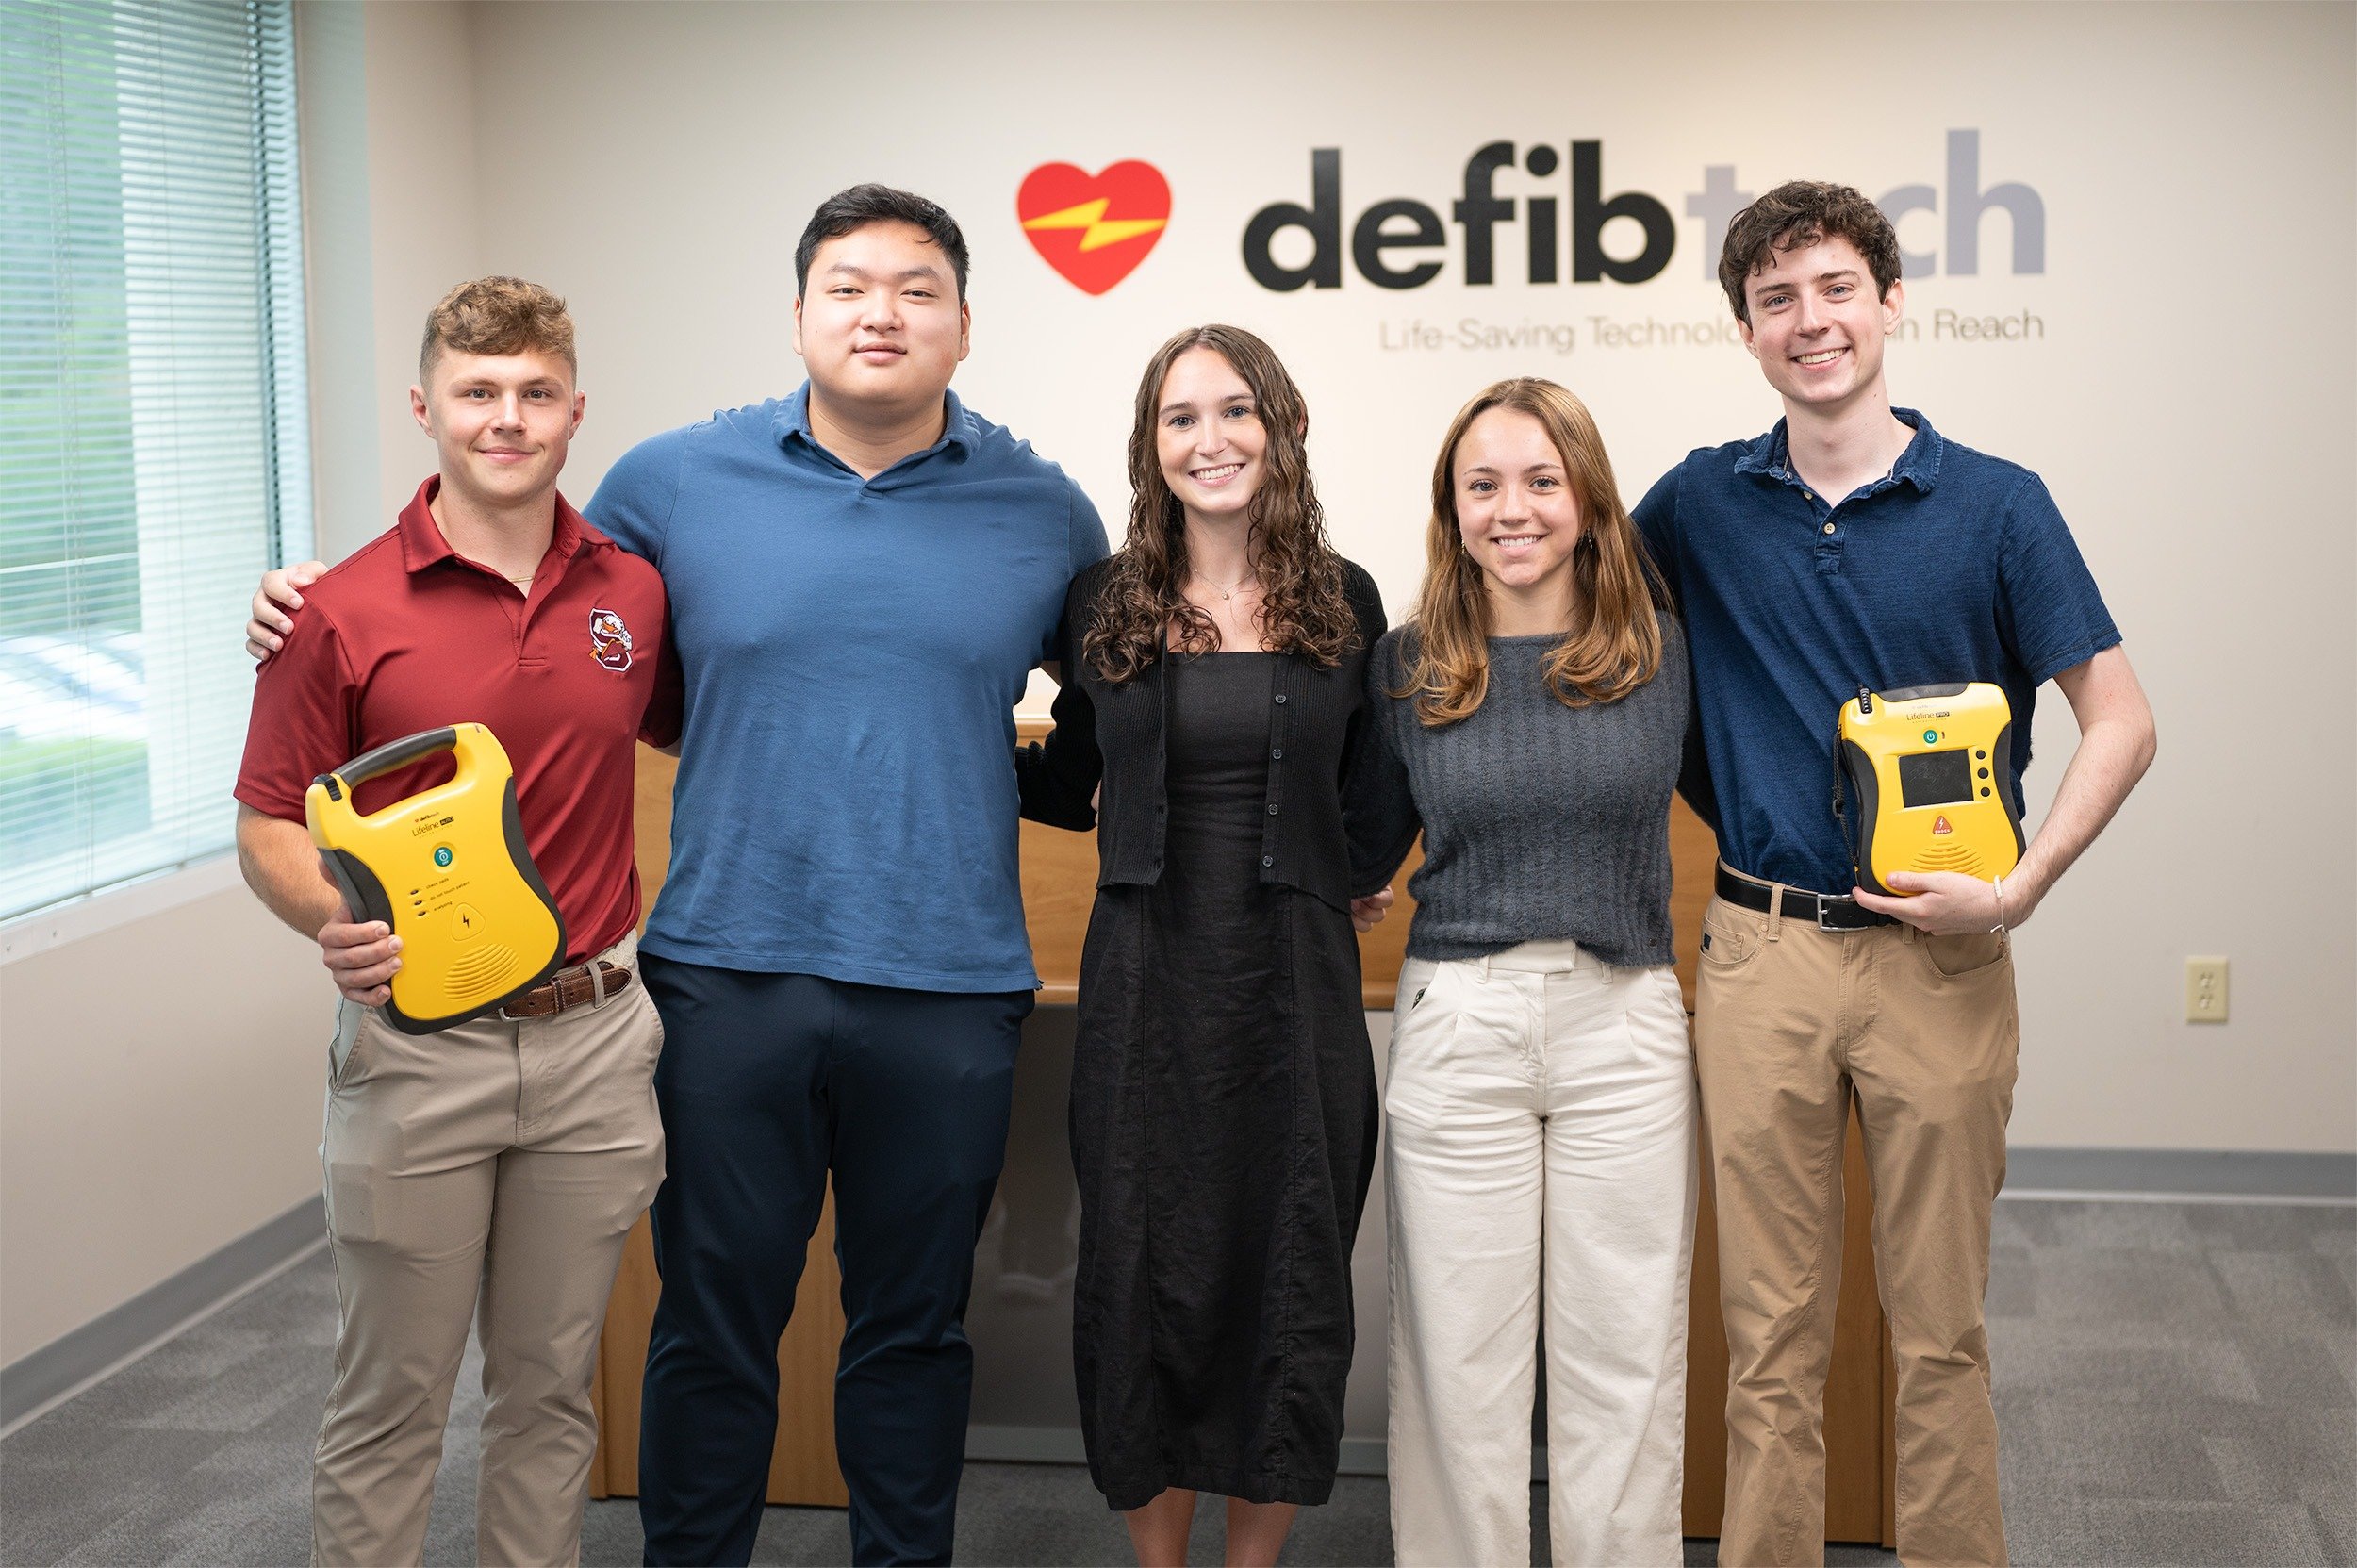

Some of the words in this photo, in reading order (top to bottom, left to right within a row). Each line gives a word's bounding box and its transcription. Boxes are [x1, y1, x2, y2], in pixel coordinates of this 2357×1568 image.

[1242, 128, 2045, 293] defibtch
[1379, 317, 1575, 355] Life-Saving
[1587, 314, 1743, 348] Technolo
[1934, 307, 2044, 342] Reach
[412, 822, 439, 836] Lifeline
